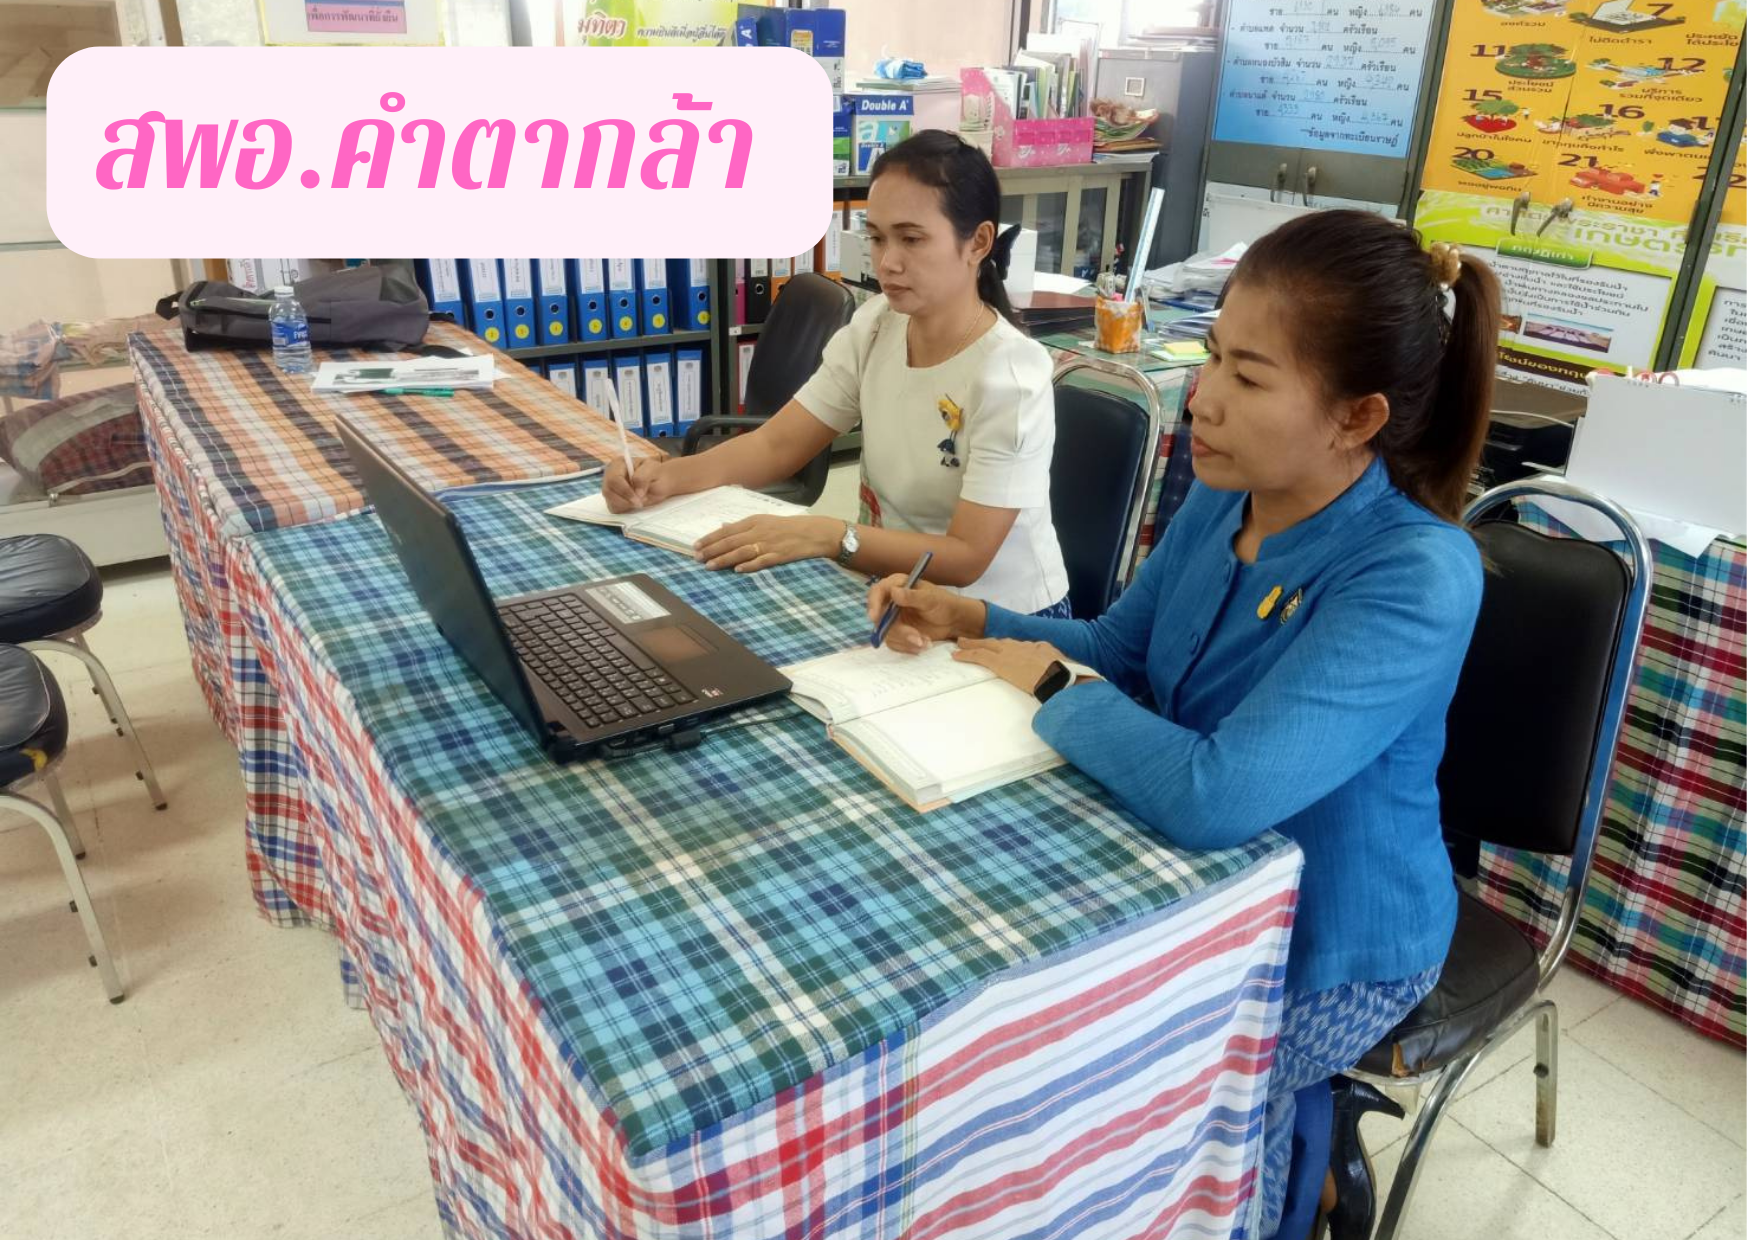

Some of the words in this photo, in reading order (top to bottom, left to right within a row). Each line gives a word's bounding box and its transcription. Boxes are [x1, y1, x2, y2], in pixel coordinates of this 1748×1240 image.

[1327, 8, 1339, 17] คน
[1409, 8, 1423, 18] คน
[1647, 3, 1674, 17] 7
[578, 12, 627, 44] มุทิตา
[1321, 44, 1334, 52] คน
[1403, 46, 1417, 55] คน
[1470, 44, 1511, 58] 11
[1657, 57, 1706, 72] 12
[1462, 88, 1503, 101] 15
[861, 99, 897, 111] Double
[898, 99, 907, 111] A
[1595, 103, 1646, 120] 16
[1452, 147, 1496, 161] 20
[1557, 153, 1599, 168] 21
